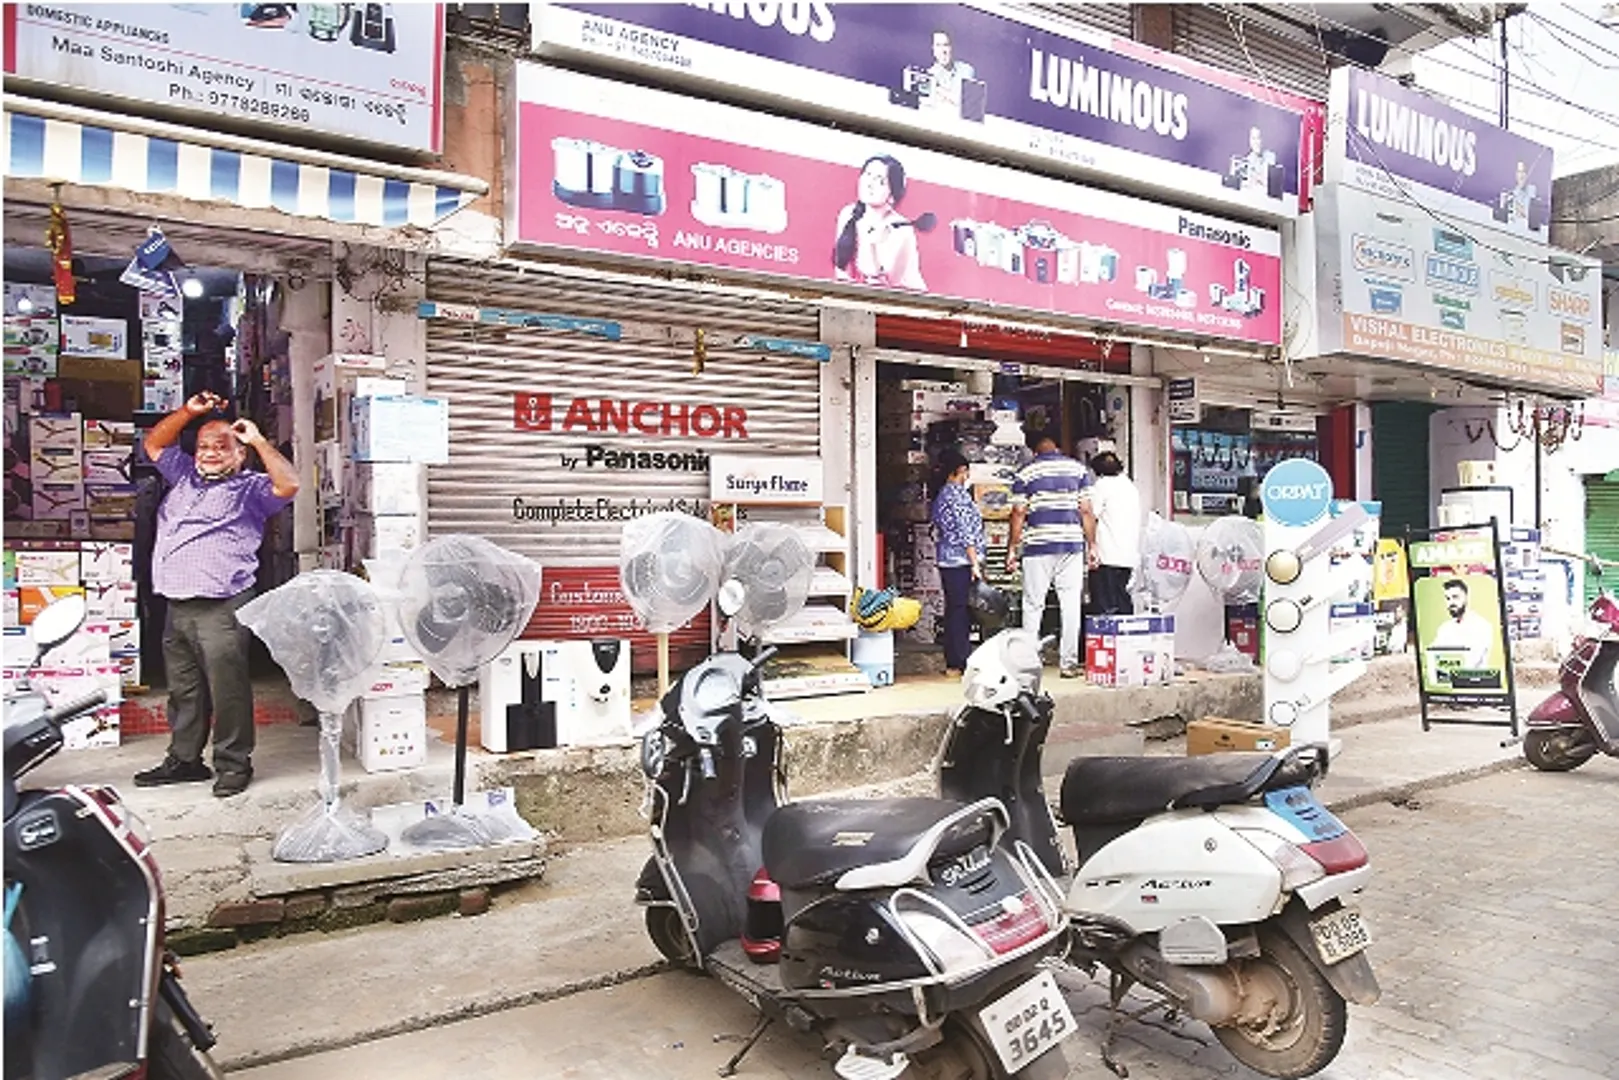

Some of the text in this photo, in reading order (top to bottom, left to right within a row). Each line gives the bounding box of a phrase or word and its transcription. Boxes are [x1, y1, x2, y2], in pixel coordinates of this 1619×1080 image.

[27, 4, 169, 44] DOMESTIC APPLIANCES
[582, 19, 613, 37] ANU
[619, 27, 679, 52] AGENCY
[52, 35, 254, 92] Maa Santoshi Agency
[1030, 48, 1188, 141] LUMINOUS
[1357, 88, 1477, 177] LUMINOUS
[673, 230, 799, 264] ANU AGENCIES
[1178, 214, 1251, 249] Panasonic
[1351, 315, 1408, 341] VISHAL
[1412, 325, 1507, 359] ELECTRONICS
[563, 397, 748, 438] ANCHOR
[560, 451, 578, 471] by
[1267, 480, 1328, 500] ORPAT
[512, 498, 594, 527] Complete
[1009, 1009, 1067, 1063] 3645
